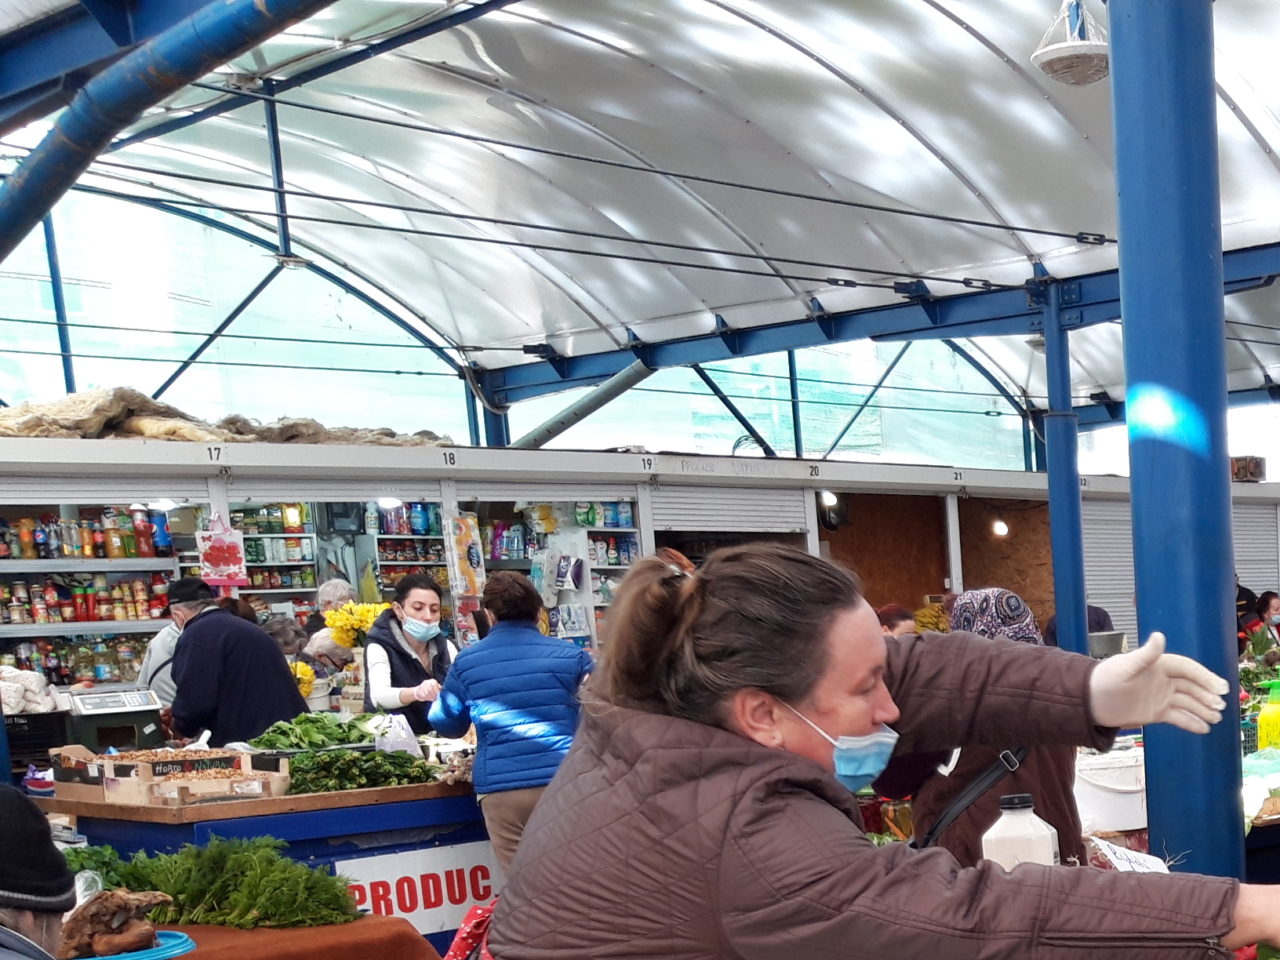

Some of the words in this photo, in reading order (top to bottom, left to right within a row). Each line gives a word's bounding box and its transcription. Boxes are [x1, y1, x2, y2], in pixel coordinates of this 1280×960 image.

[207, 447, 221, 461] 17
[442, 452, 456, 465] 18
[642, 458, 653, 470] 19
[809, 465, 820, 477] 20
[954, 472, 963, 481] 21
